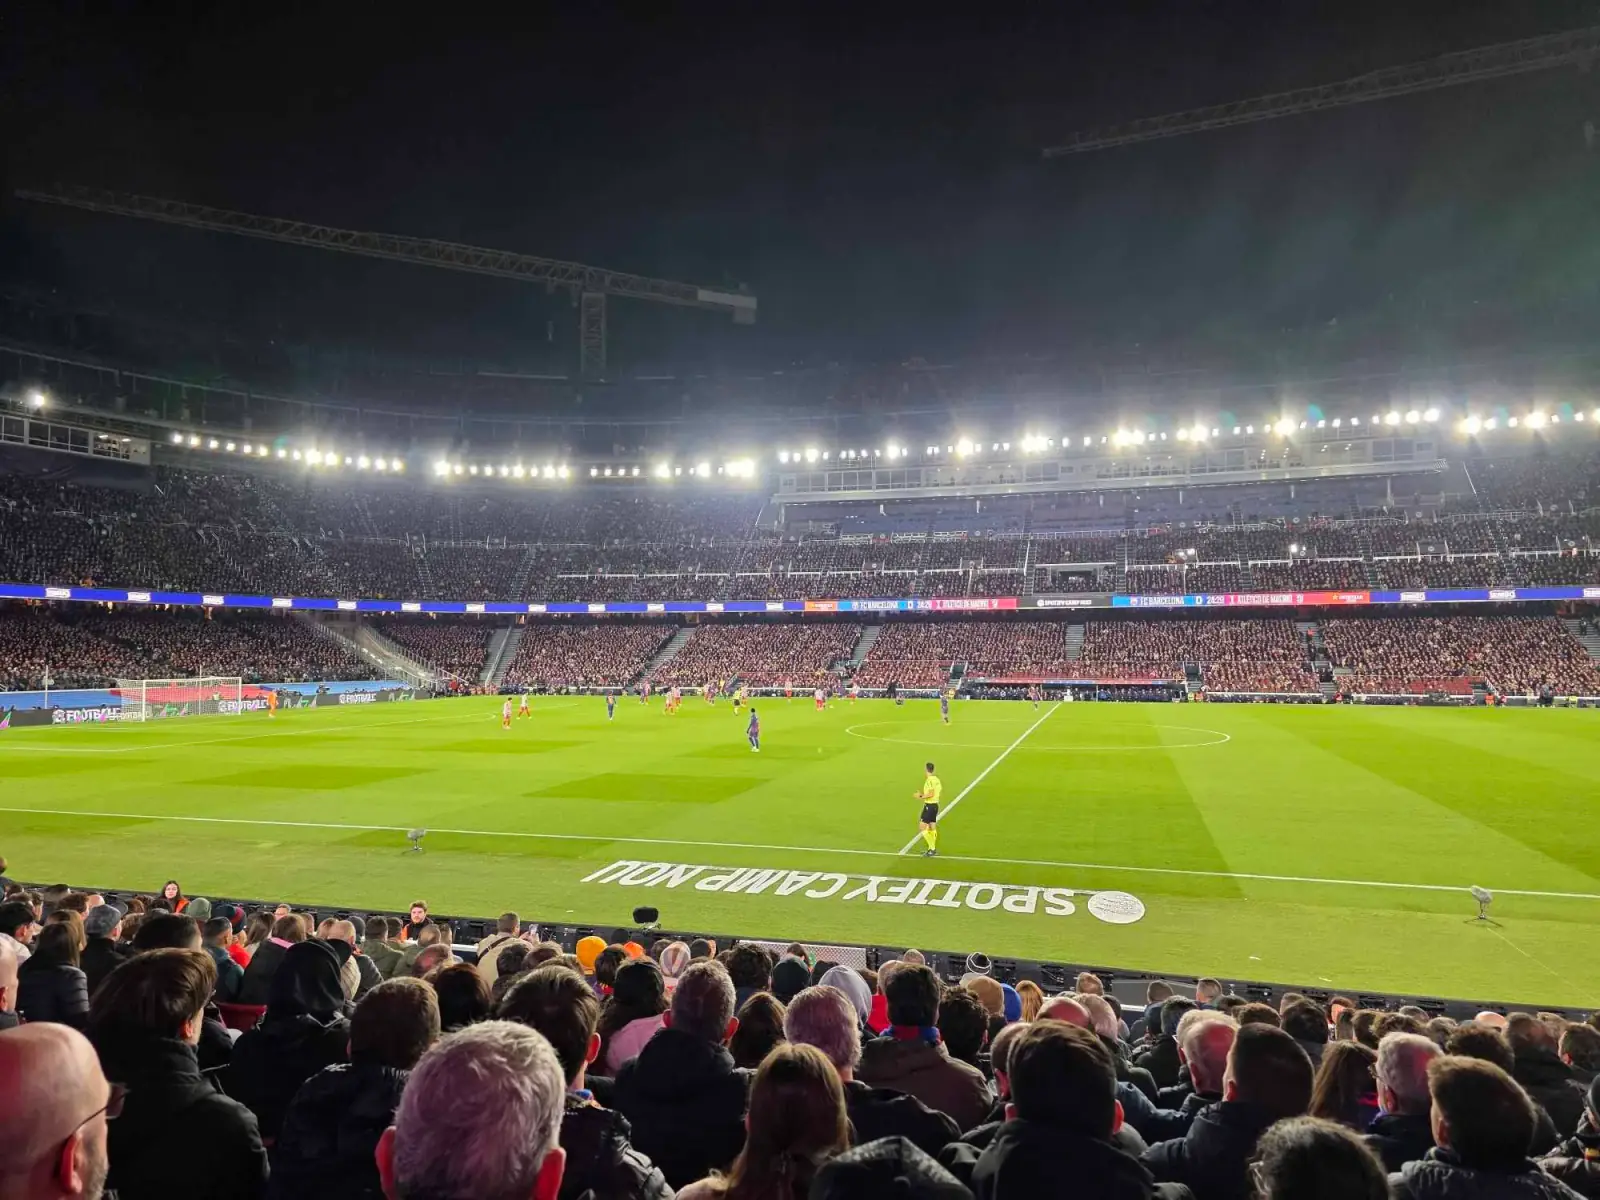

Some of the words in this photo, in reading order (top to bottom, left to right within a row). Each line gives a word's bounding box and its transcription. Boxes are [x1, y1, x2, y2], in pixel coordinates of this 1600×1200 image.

[1149, 596, 1184, 605] BARCELONA
[580, 859, 701, 889] NOU
[694, 867, 848, 899] CAMP
[848, 875, 1077, 916] SPOTIFY
